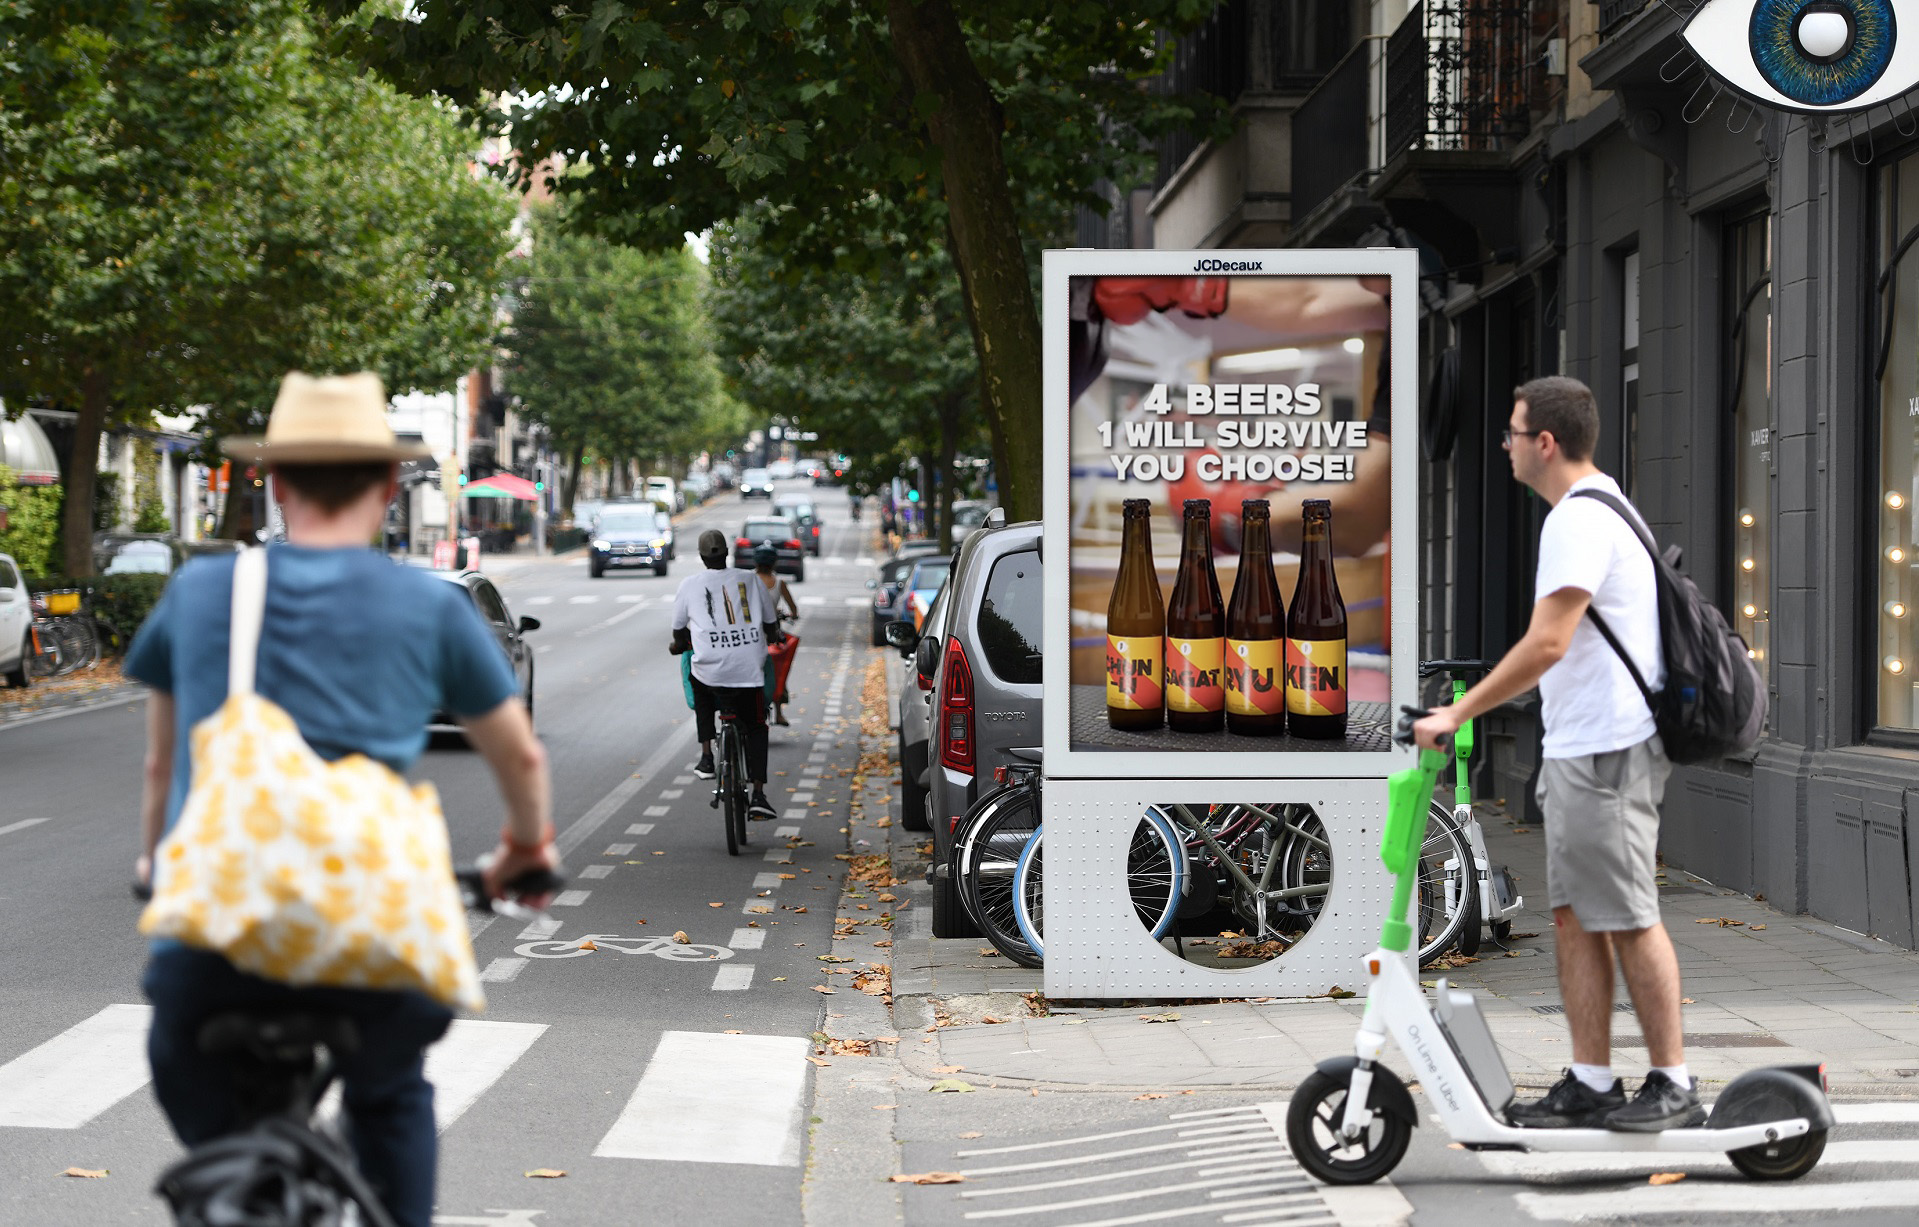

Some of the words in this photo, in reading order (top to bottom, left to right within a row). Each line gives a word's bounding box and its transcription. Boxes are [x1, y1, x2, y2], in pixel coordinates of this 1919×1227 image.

[1193, 259, 1263, 272] JCDecaux
[1144, 383, 1172, 415] 4
[1187, 383, 1321, 415] BEERS
[1909, 396, 1919, 416] XA
[1097, 421, 1112, 448] 1
[1124, 421, 1205, 448] WILL
[1216, 421, 1368, 448] SURVIVE
[1110, 455, 1185, 481] YOU
[1197, 455, 1355, 481] CHOOSE!
[709, 627, 760, 648] PABLO
[1226, 666, 1274, 693] RYU
[1286, 663, 1339, 691] KEN
[984, 711, 1028, 722] TOYOTA
[1408, 1025, 1421, 1042] On
[1418, 1043, 1437, 1073] Lime
[1440, 1082, 1460, 1112] Uber
